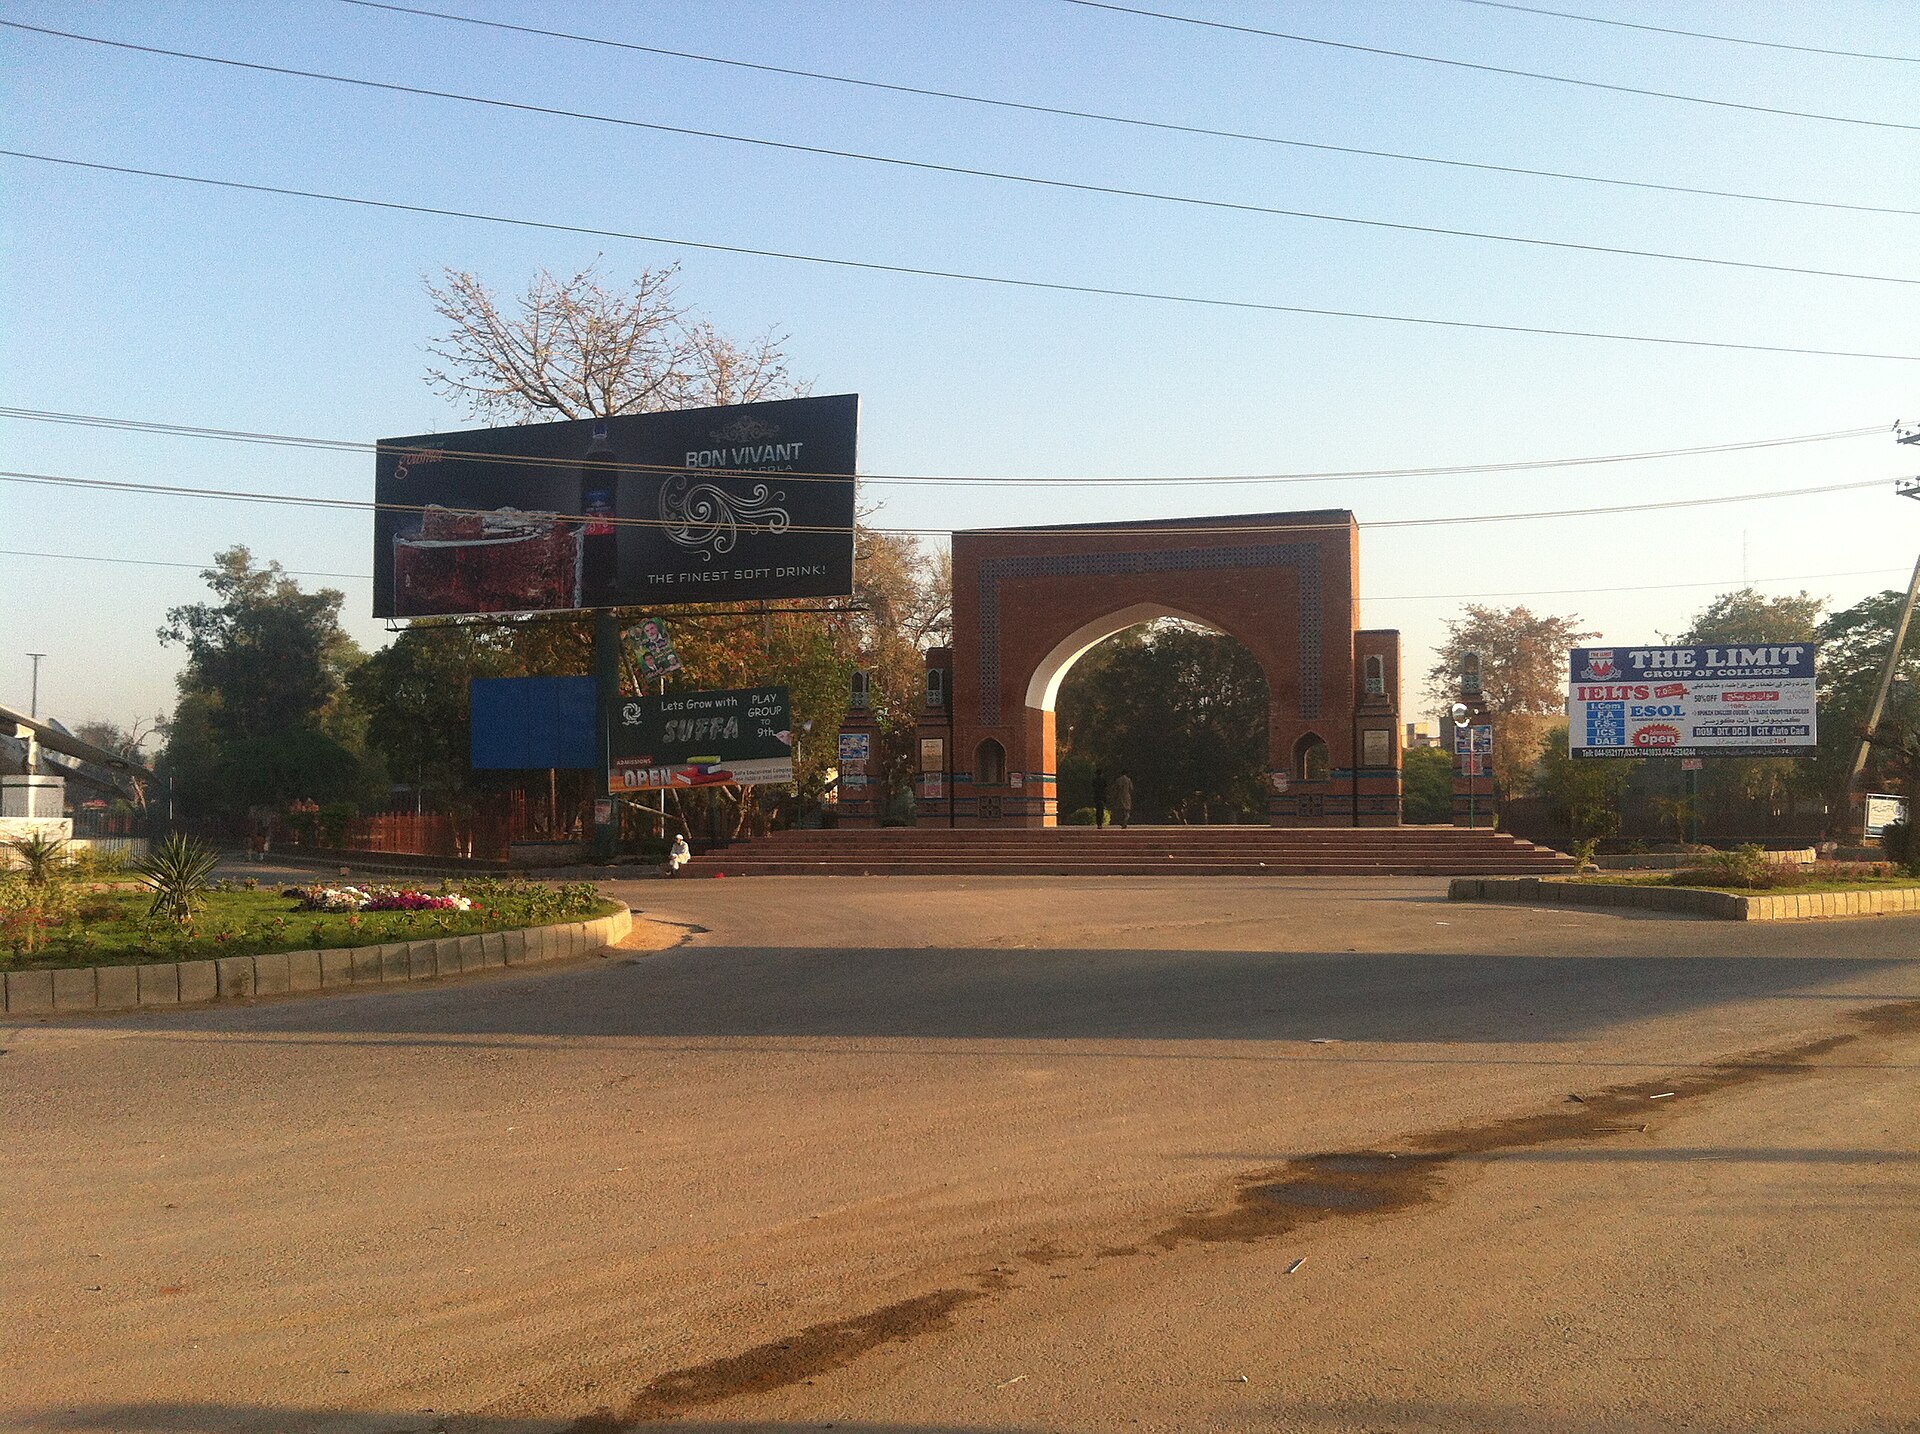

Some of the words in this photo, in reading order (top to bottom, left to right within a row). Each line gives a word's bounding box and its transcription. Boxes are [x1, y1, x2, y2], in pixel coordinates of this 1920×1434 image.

[686, 449, 726, 469] BON
[731, 442, 804, 465] VIVANT
[647, 572, 675, 585] THE
[679, 570, 729, 583] FINEST
[733, 568, 770, 581] SOFT
[775, 564, 827, 579] DRINK!
[1628, 650, 1697, 669] THE
[1705, 646, 1804, 666] LIMIT
[1643, 671, 1692, 679] GROUP
[1695, 670, 1714, 678] OF
[1717, 667, 1790, 677] COLLEGES
[751, 694, 777, 704] PLAY
[1577, 685, 1650, 701] IELTS
[660, 701, 684, 712] Lets
[686, 700, 713, 709] Grow
[715, 697, 738, 708] with
[1630, 705, 1686, 717] ESOL
[747, 706, 782, 718] GROUP
[662, 716, 739, 744] SUFFA
[756, 727, 776, 738] 9th
[1771, 726, 1789, 735] Auto
[1790, 726, 1805, 735] Cad
[1639, 733, 1675, 746] Open
[616, 758, 651, 766] ADMISSIONS
[623, 769, 672, 788] OPEN
